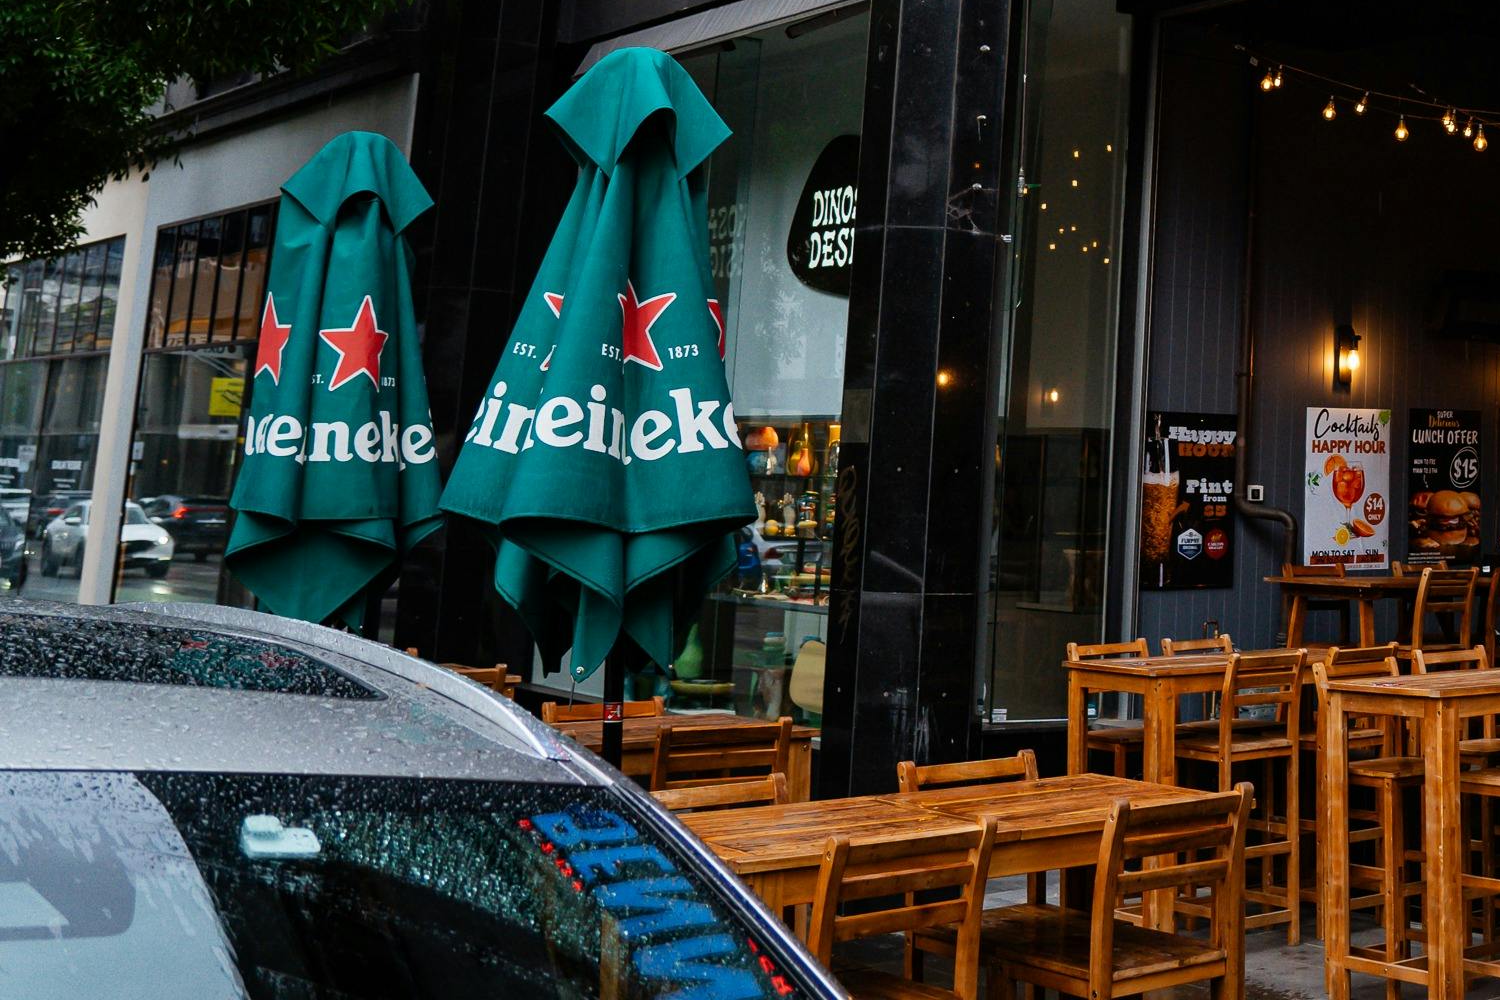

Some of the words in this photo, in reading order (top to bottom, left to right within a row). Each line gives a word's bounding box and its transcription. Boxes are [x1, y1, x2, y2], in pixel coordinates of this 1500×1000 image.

[512, 341, 537, 359] EST.
[668, 344, 699, 360] 1873
[1314, 408, 1380, 441] Cocktails
[1168, 426, 1237, 446] Happy
[1412, 429, 1444, 445] LUNCH
[1447, 430, 1479, 445] OFFER
[1312, 440, 1352, 454] HAPPY
[1354, 441, 1386, 454] HOUR
[1453, 458, 1478, 481] $15
[1186, 478, 1233, 494] Pint
[1203, 494, 1228, 502] from
[1366, 497, 1383, 512] $14
[1368, 513, 1382, 521] ONLY
[1342, 549, 1355, 557] SAT
[1365, 549, 1379, 557] SUN
